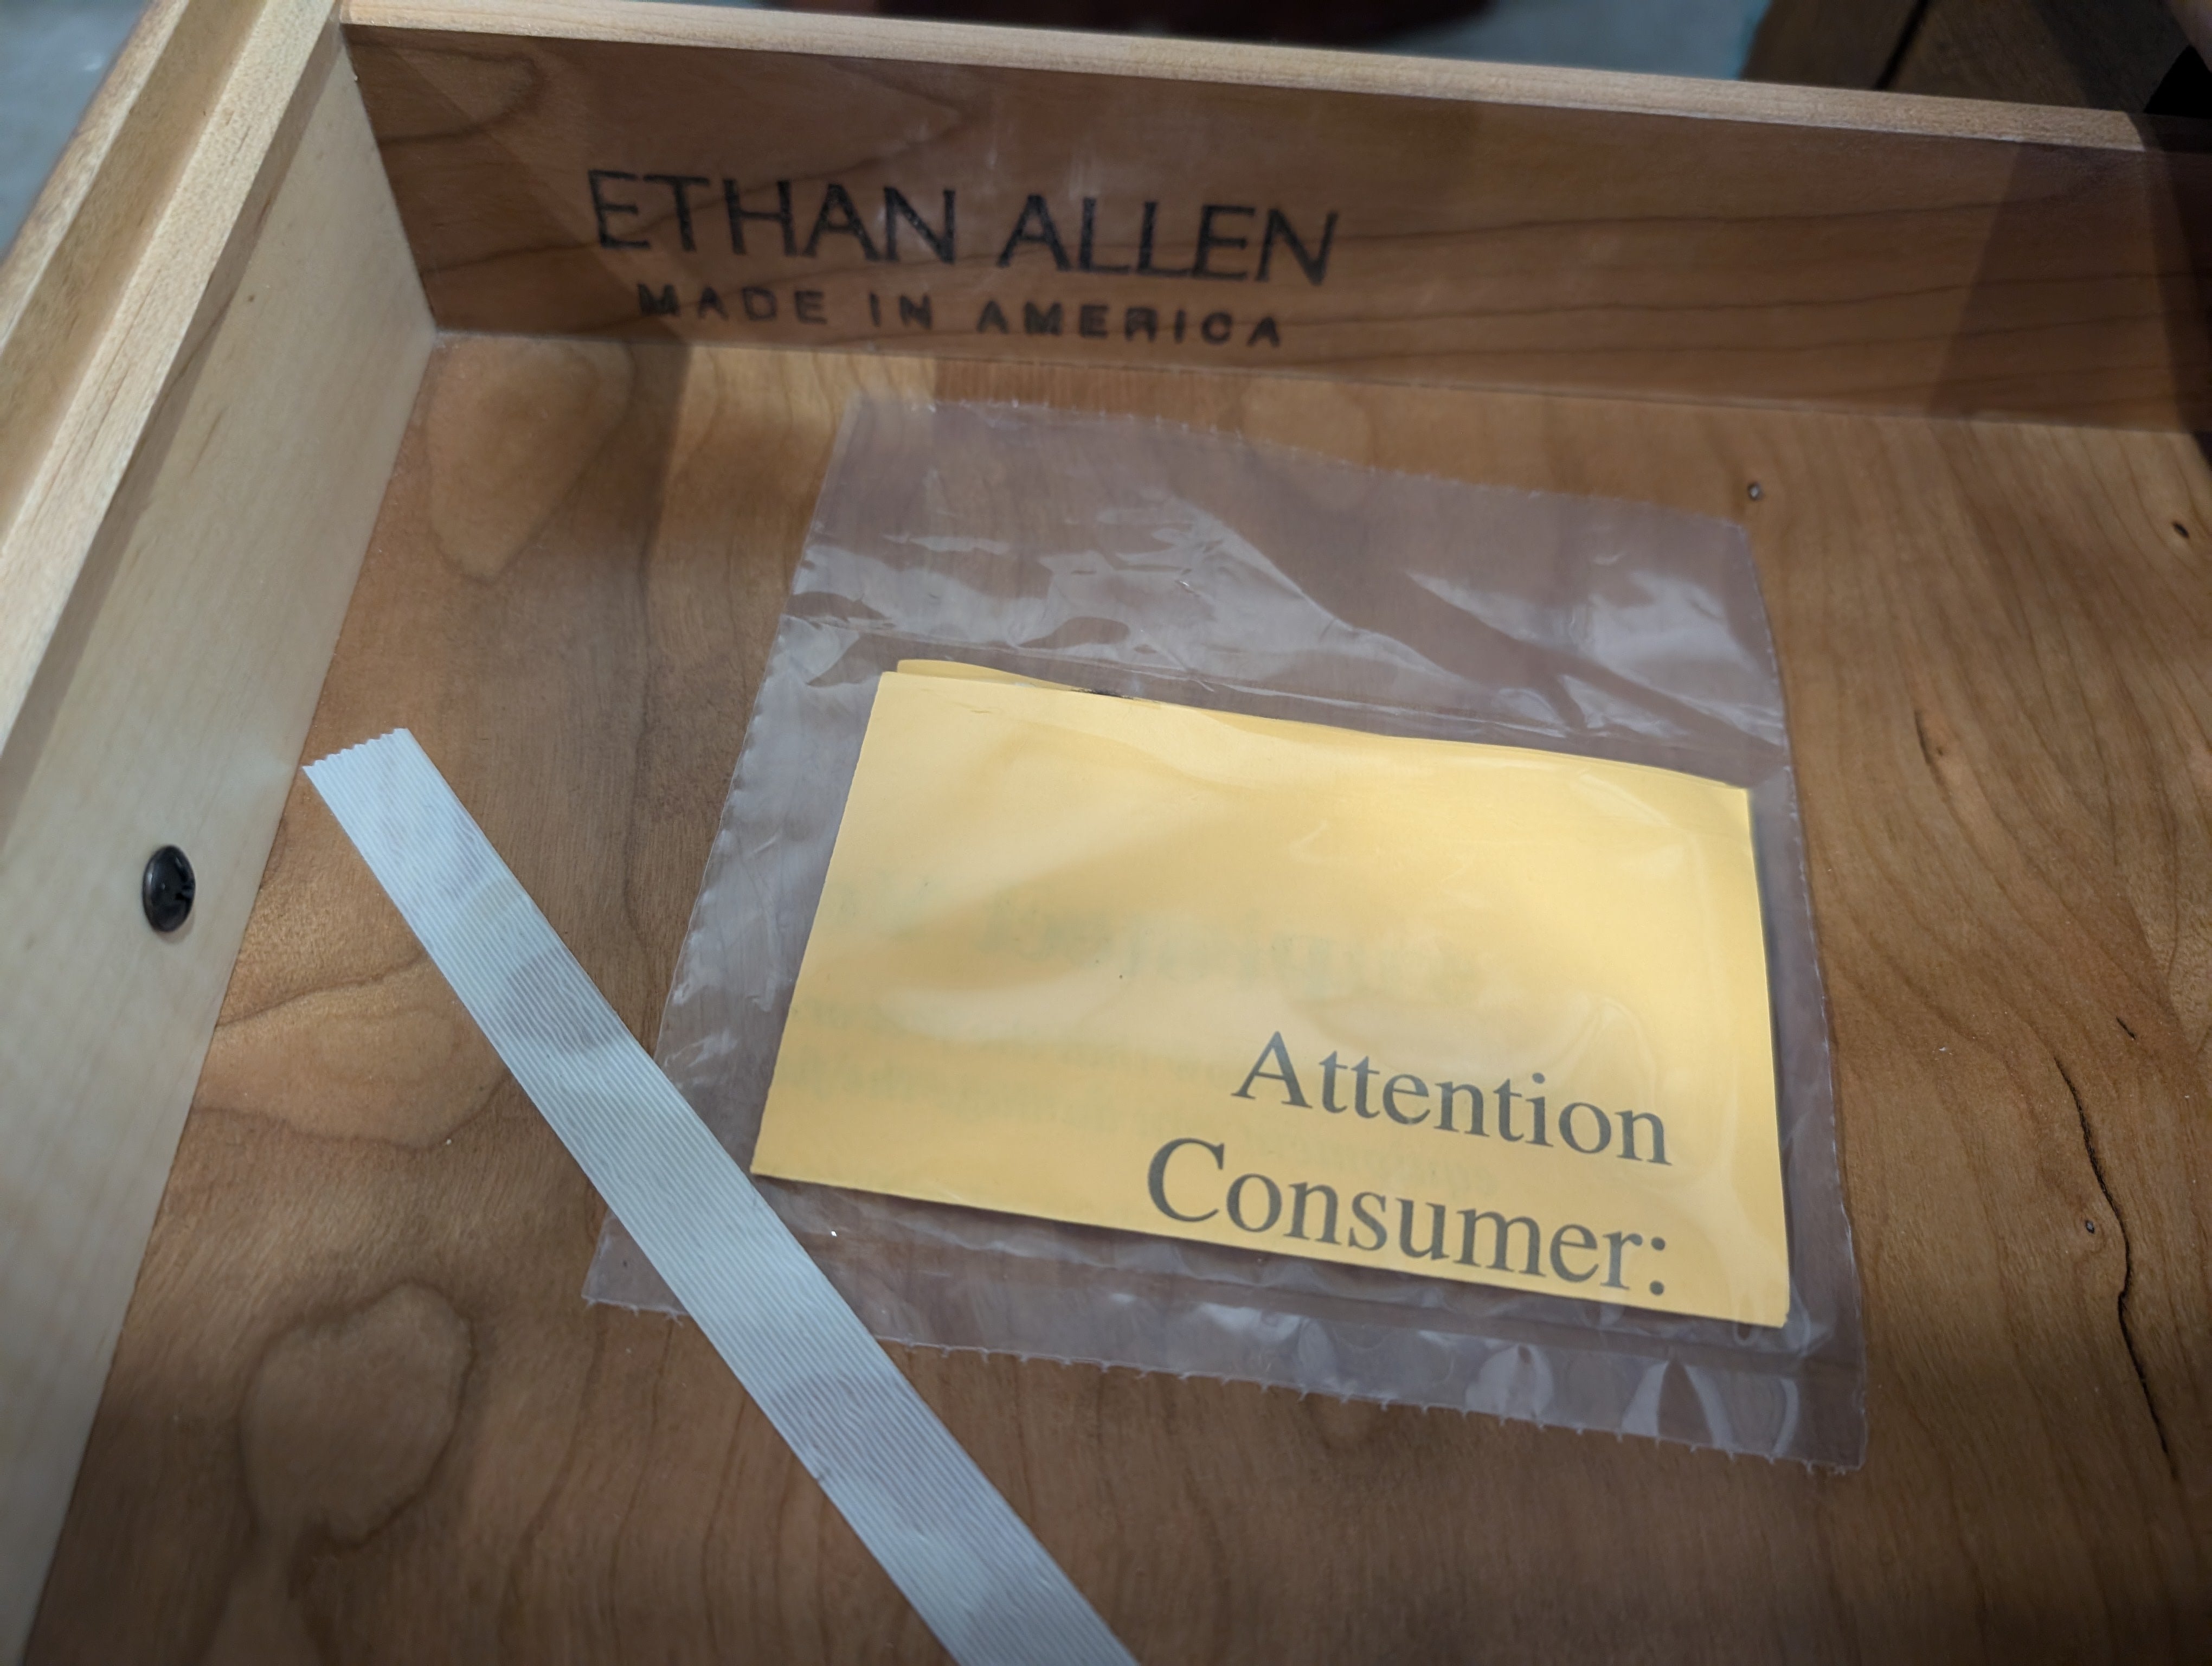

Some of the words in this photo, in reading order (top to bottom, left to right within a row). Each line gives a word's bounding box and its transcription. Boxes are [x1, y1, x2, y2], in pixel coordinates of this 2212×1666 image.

[588, 169, 956, 265] ETHAN
[996, 194, 1338, 285] ALLEN
[638, 284, 827, 324] MADE
[869, 293, 934, 330] IN
[976, 300, 1281, 347] AMERICA
[1231, 1031, 1671, 1165] Attention
[1148, 1138, 1666, 1295] Consumer:
